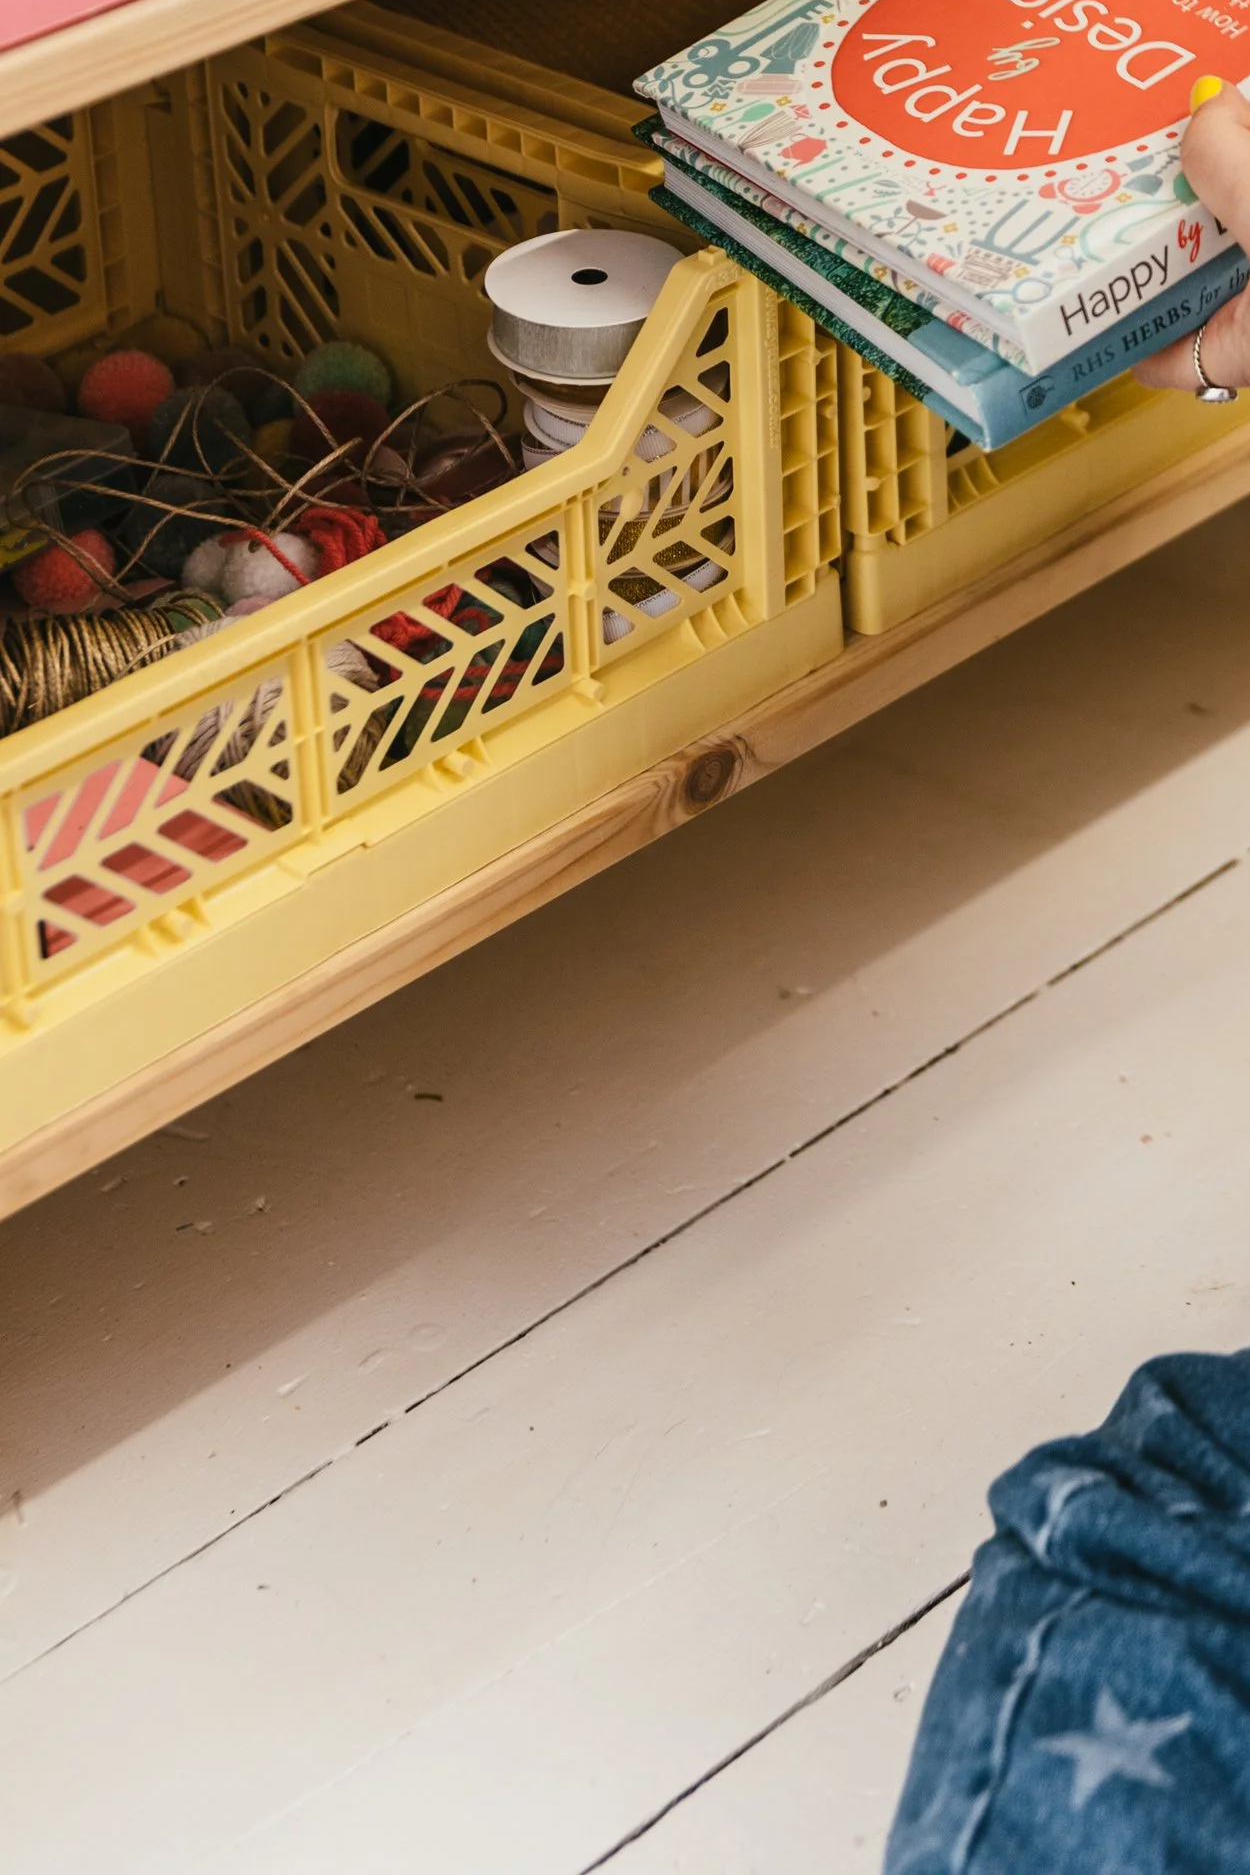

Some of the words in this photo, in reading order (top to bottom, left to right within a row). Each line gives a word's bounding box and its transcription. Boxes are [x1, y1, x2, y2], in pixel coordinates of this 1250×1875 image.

[985, 36, 1061, 81] by
[1195, 5, 1248, 39] How
[861, 32, 1073, 156] Happy
[1060, 245, 1169, 336] Happy
[1177, 219, 1203, 263] by
[1071, 347, 1116, 383] RHS
[1122, 299, 1192, 353] HERBS
[1196, 285, 1222, 316] for
